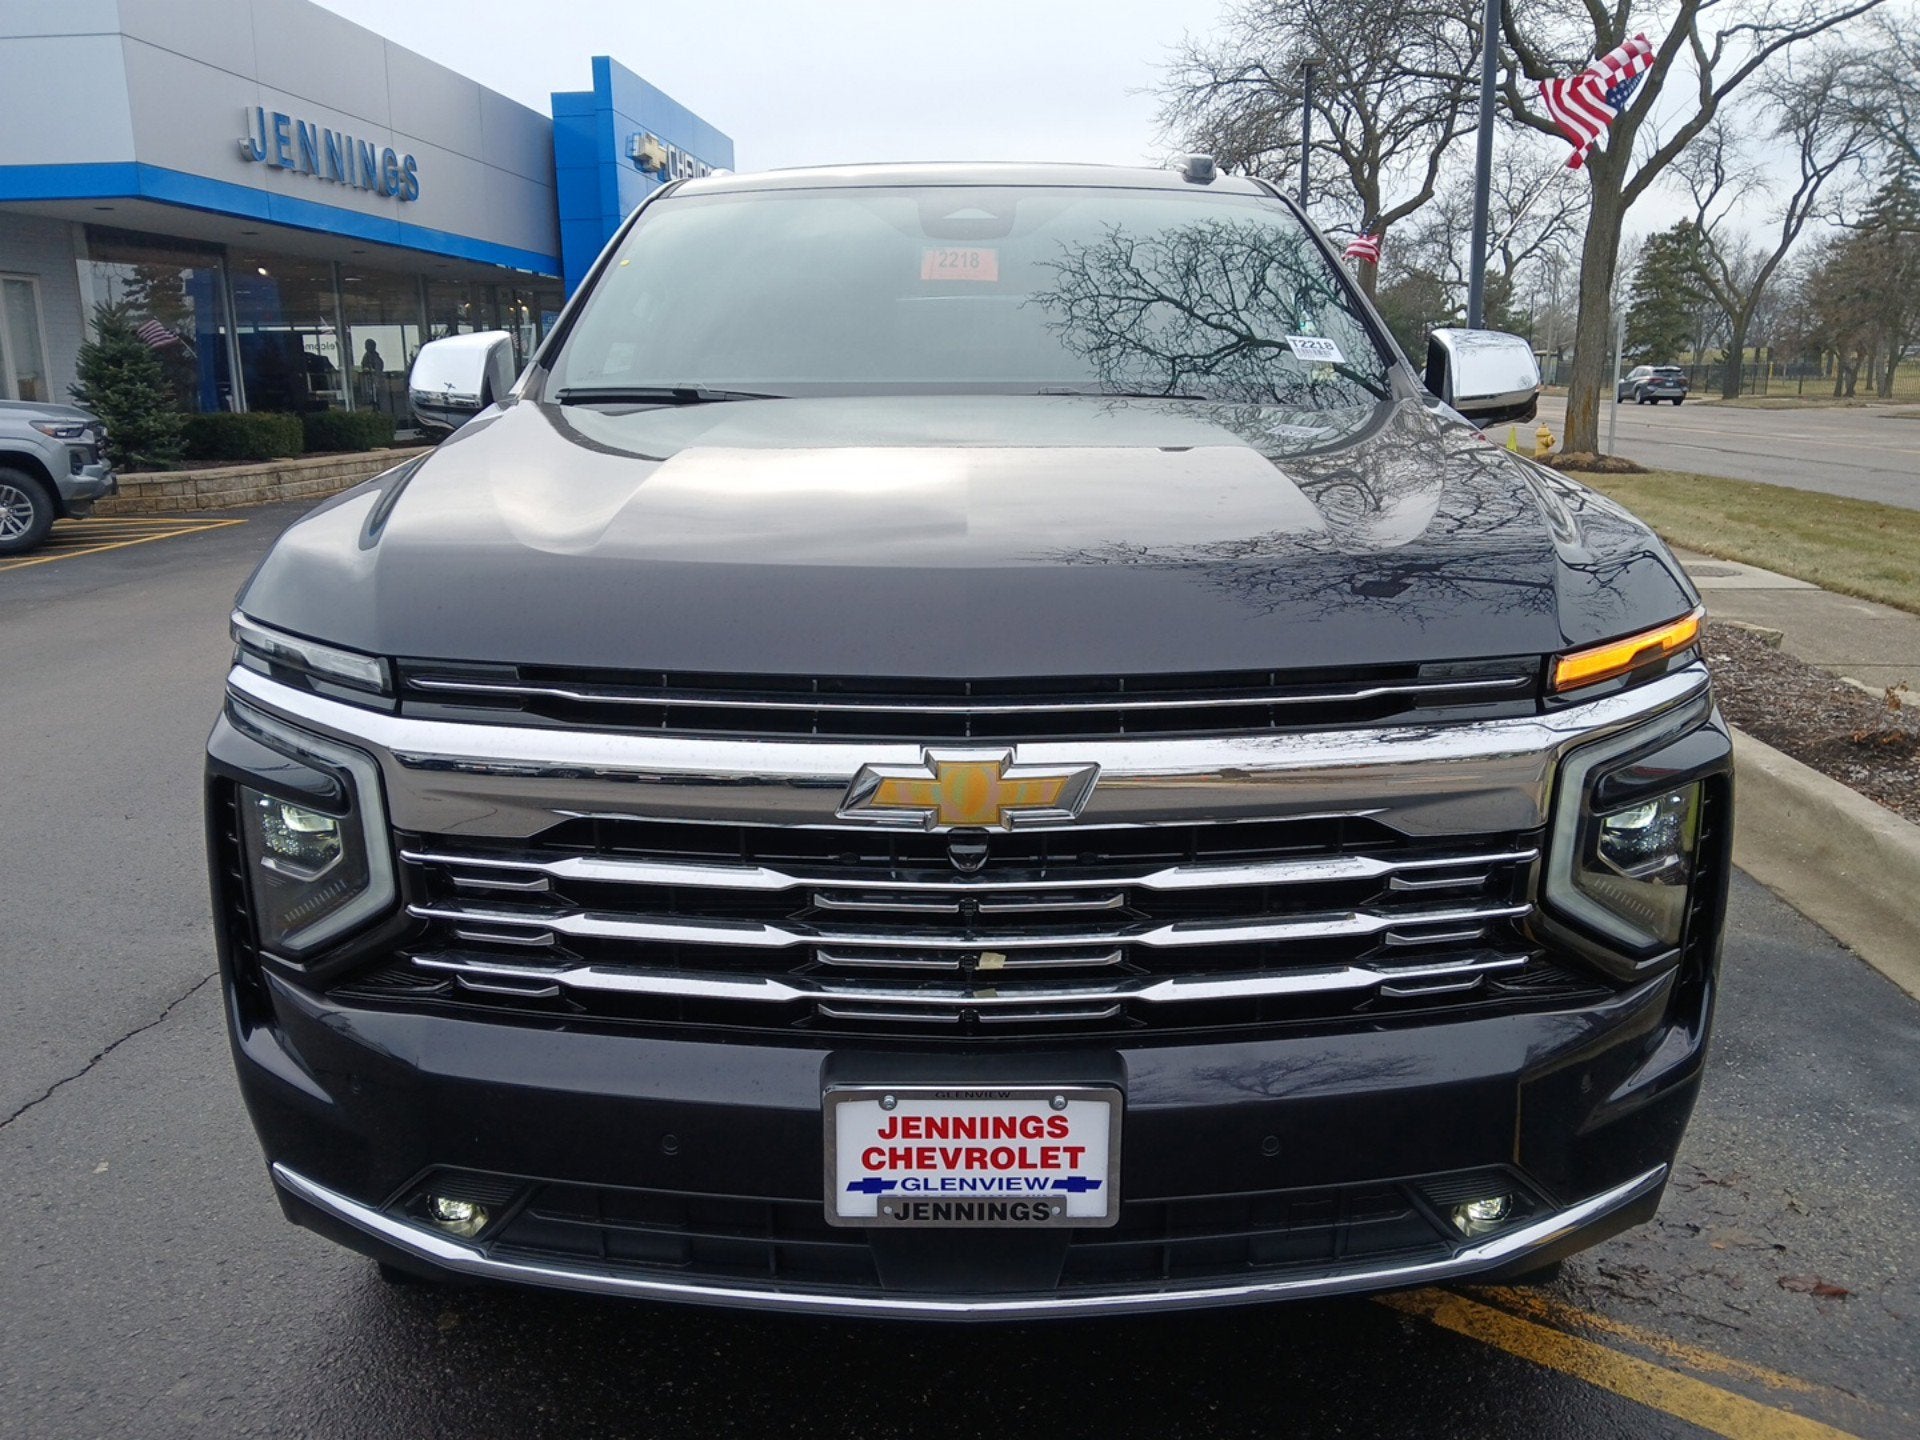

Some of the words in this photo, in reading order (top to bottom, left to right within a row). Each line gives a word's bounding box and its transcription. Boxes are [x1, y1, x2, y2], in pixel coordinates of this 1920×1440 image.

[239, 106, 419, 201] JENNINGS
[938, 250, 980, 268] 2218
[1290, 340, 1334, 350] T2218
[877, 1115, 1070, 1140] JENNINGS
[861, 1146, 1086, 1171] CHEVROLET
[900, 1177, 1051, 1192] GLENVIEW
[893, 1202, 1050, 1222] JENNINGS
